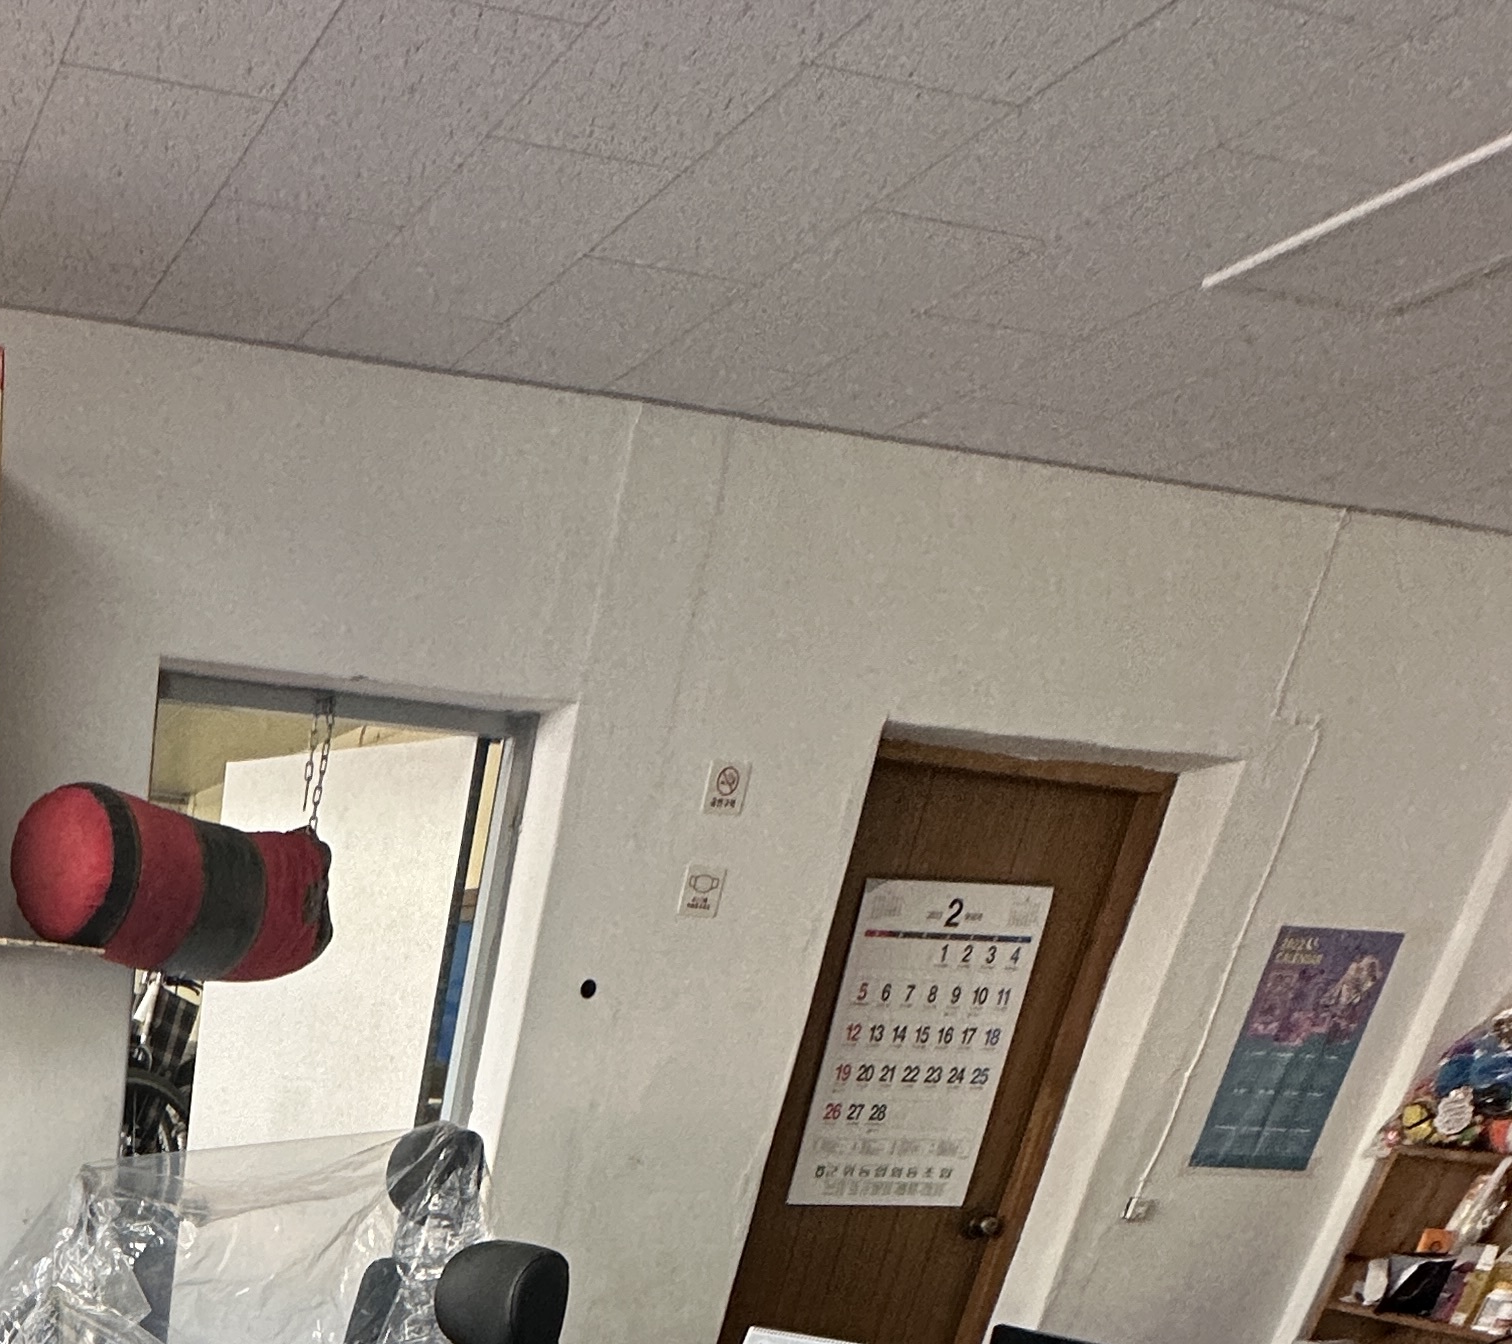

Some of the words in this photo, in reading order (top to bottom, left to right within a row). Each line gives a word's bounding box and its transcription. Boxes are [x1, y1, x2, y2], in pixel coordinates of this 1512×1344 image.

[944, 898, 964, 928] 2
[940, 944, 949, 963] 1
[961, 945, 974, 963] 2
[985, 945, 998, 964] 3
[1010, 946, 1022, 965] 4
[856, 983, 869, 1001] 5
[881, 983, 892, 1003] 6
[904, 984, 916, 1002] 7
[927, 985, 938, 1003] 8
[950, 985, 962, 1004] 9
[972, 986, 989, 1005] 10
[996, 988, 1012, 1006] 11
[846, 1023, 862, 1042] 12
[870, 1024, 885, 1042] 13
[892, 1025, 908, 1043] 14
[915, 1025, 931, 1044] 15
[938, 1026, 954, 1044] 16
[961, 1027, 978, 1045] 17
[985, 1028, 1002, 1046] 18
[835, 1063, 852, 1082] 19
[856, 1064, 875, 1082] 20
[879, 1065, 897, 1083] 21
[900, 1065, 921, 1083] 22
[923, 1066, 943, 1084] 23
[946, 1067, 966, 1084] 24
[969, 1067, 990, 1085] 25
[823, 1103, 841, 1120] 26
[846, 1104, 865, 1121] 27
[868, 1104, 887, 1121] 28
